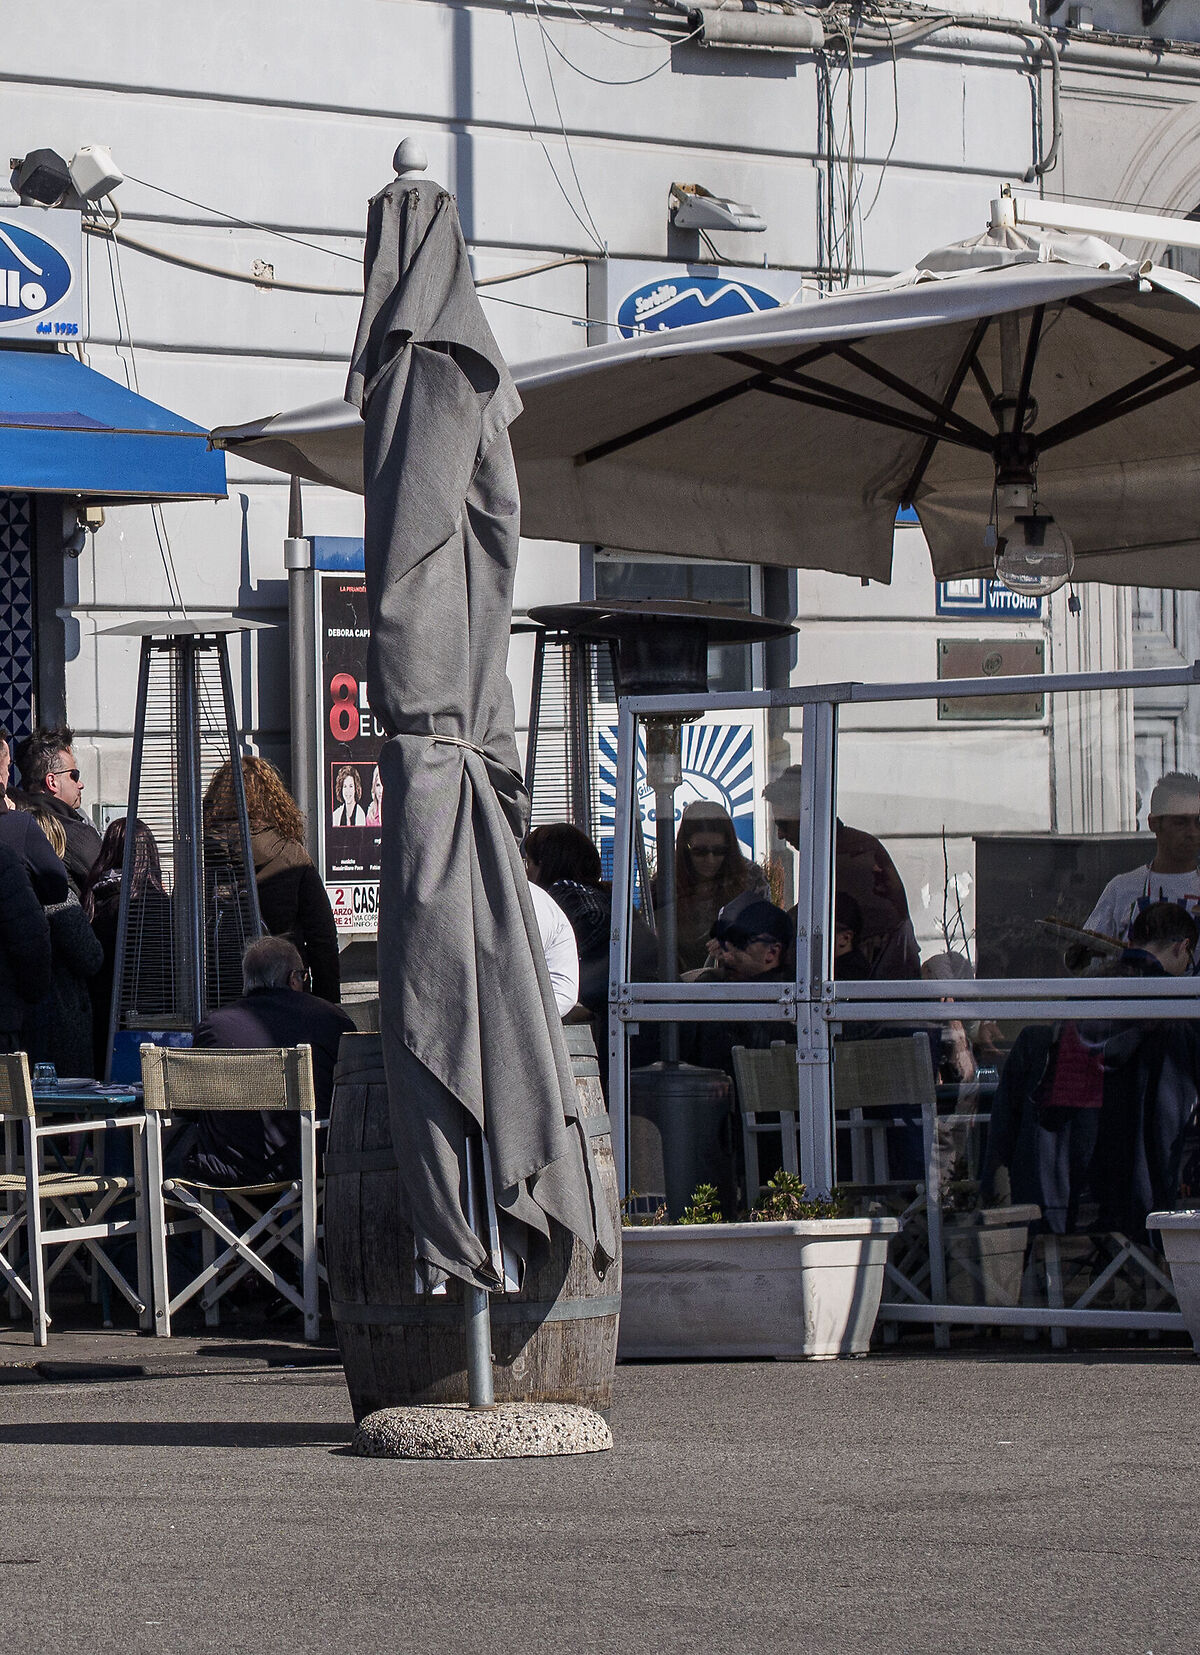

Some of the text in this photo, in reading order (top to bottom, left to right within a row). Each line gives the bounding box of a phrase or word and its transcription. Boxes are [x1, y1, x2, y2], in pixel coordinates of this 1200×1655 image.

[635, 284, 677, 314] Sorbillo
[36, 321, 52, 334] dal
[989, 590, 1038, 609] VITTORIA
[328, 628, 354, 637] DEBORA
[330, 673, 359, 741] 8
[335, 888, 345, 905] 2
[344, 917, 352, 925] 21
